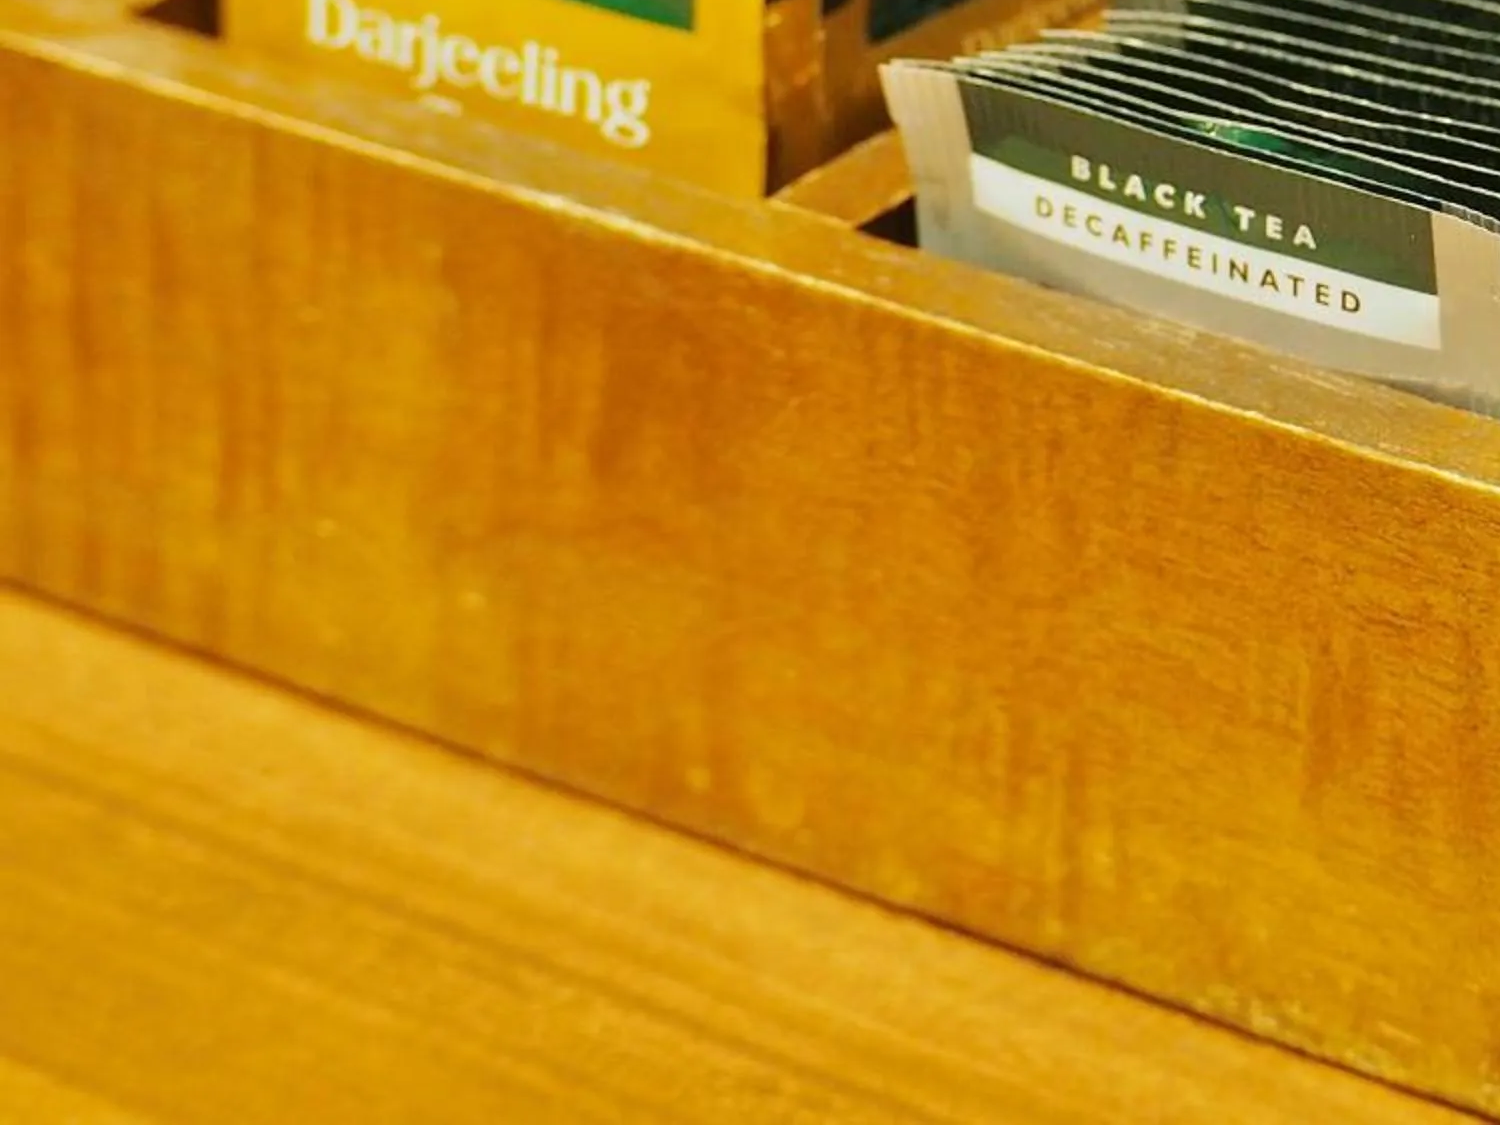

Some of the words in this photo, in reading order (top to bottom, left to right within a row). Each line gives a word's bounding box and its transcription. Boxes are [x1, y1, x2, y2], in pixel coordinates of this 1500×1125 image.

[1034, 194, 1363, 315] DECAFFEINATED
[1070, 154, 1207, 219] BLACK
[1232, 205, 1318, 251] TEA
